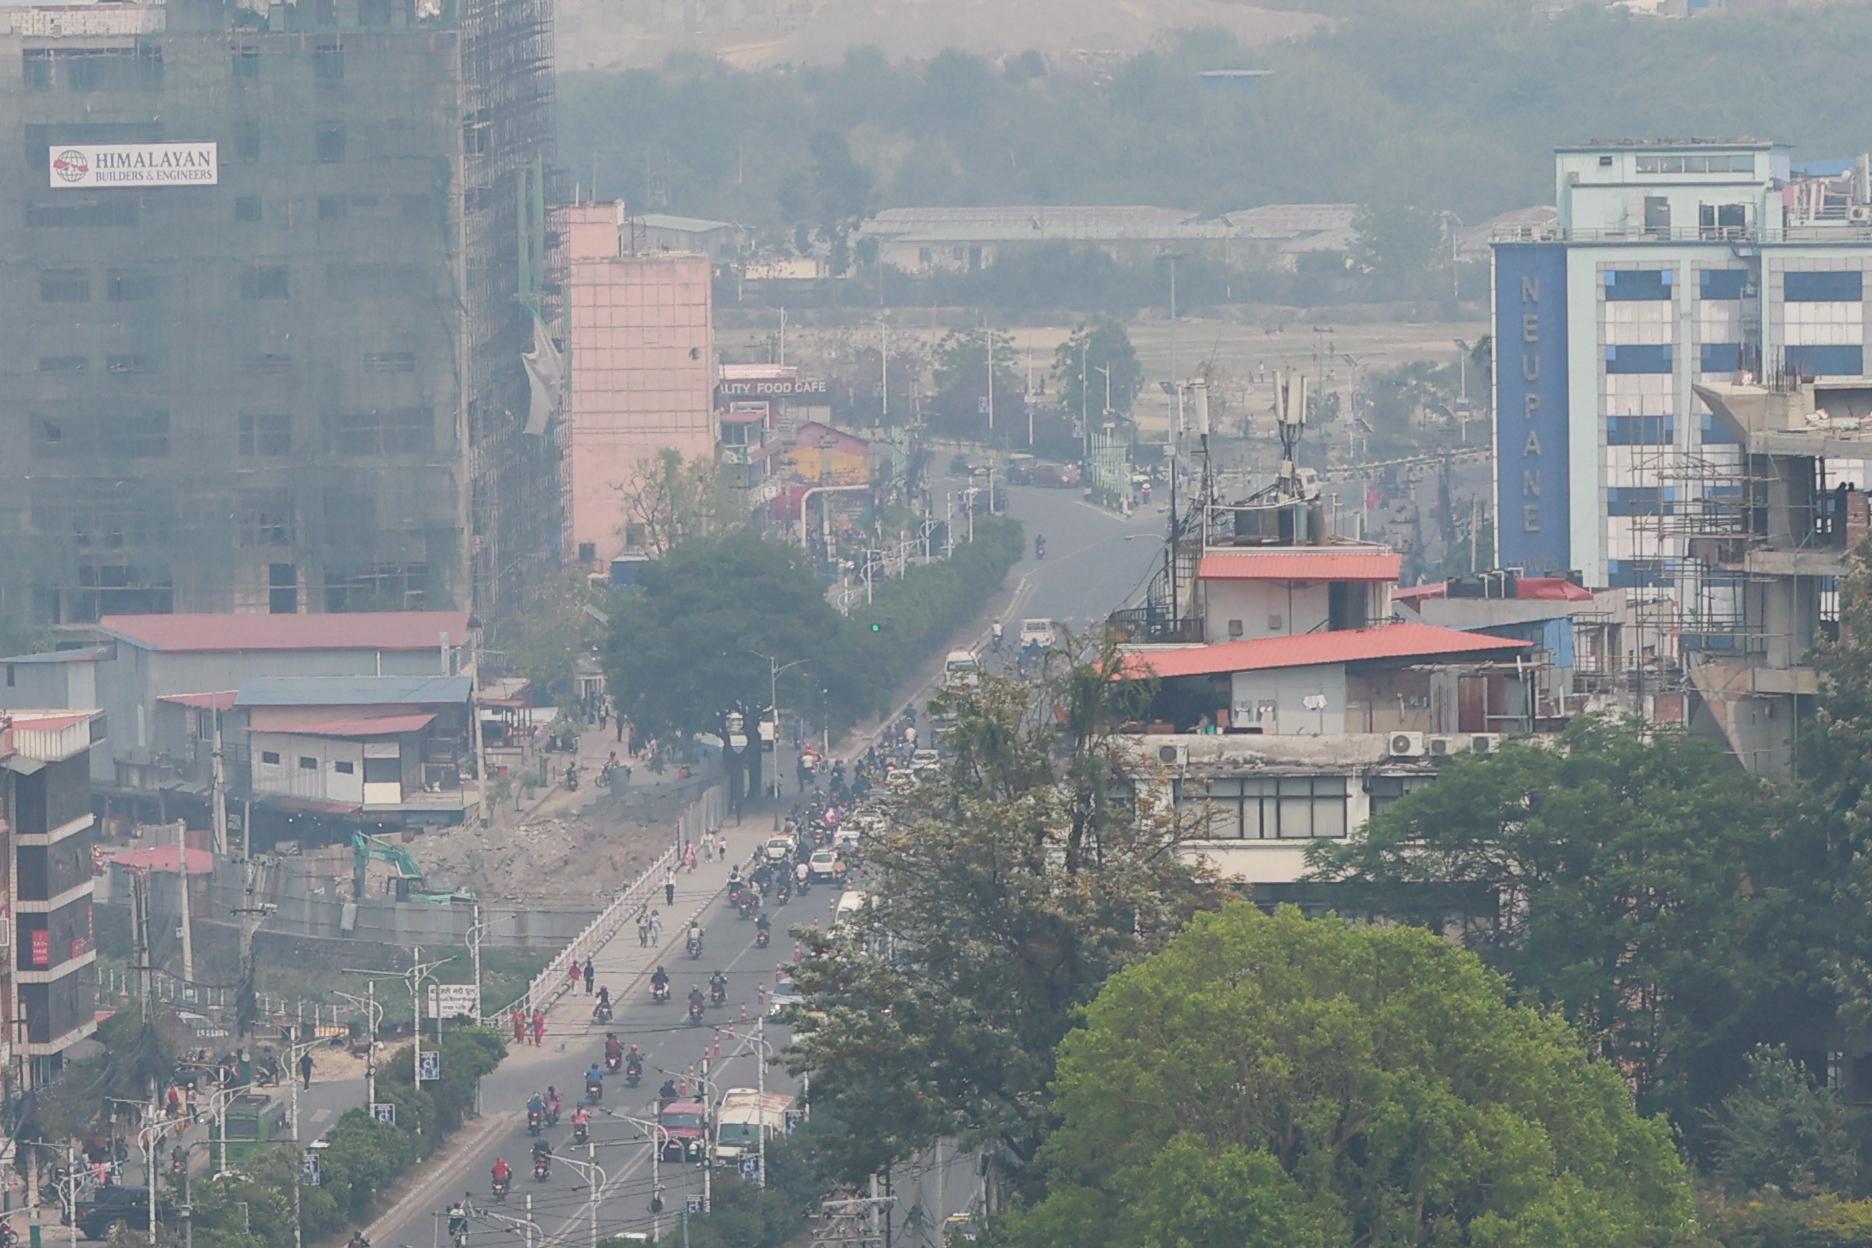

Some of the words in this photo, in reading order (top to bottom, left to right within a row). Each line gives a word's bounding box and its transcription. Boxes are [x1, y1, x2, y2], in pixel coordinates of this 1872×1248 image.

[96, 151, 211, 168] HIMALAYAN
[96, 170, 144, 182] BUILDERS
[146, 171, 155, 181] &
[156, 169, 213, 181] ENGINEERS
[757, 382, 791, 393] FOOD
[795, 381, 827, 393] CAFE
[1521, 274, 1543, 533] NEUPANE
